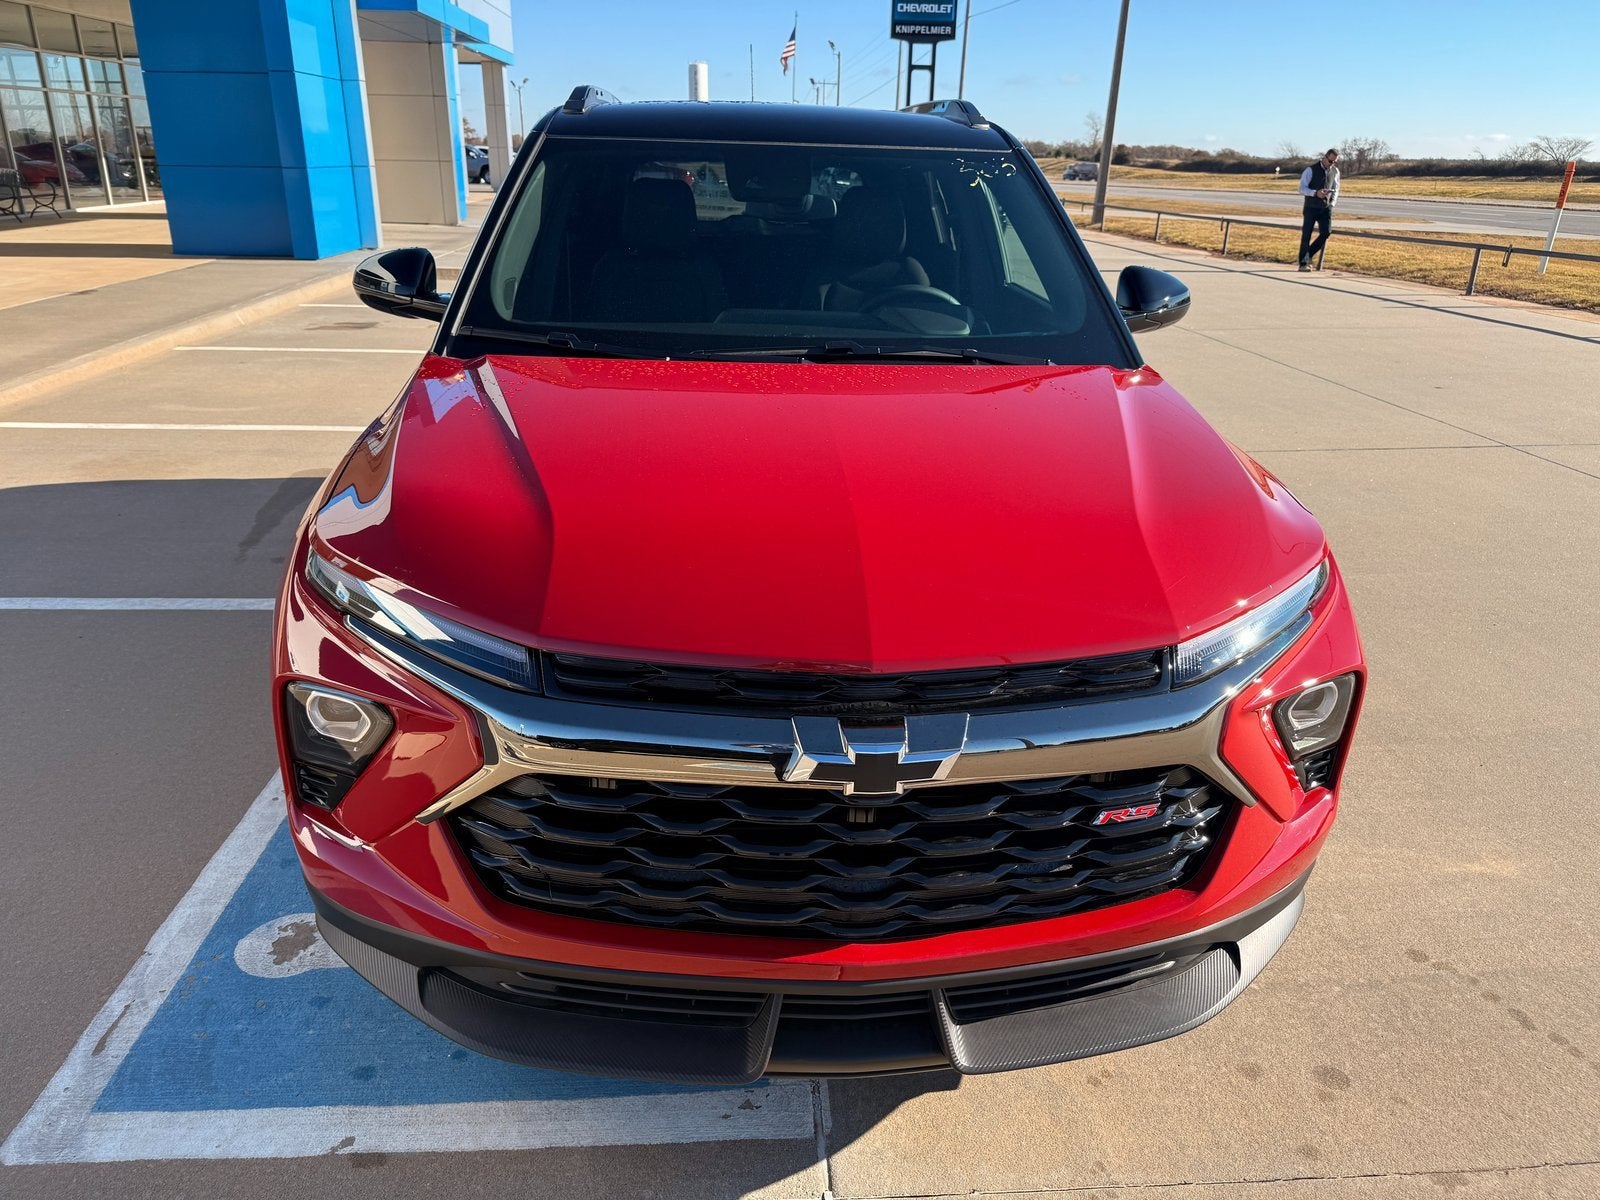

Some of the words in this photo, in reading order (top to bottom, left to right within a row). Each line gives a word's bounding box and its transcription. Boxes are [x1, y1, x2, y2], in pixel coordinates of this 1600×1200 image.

[897, 3, 952, 13] CHEVROLET
[895, 25, 951, 34] KNIPPELMIER
[1092, 803, 1160, 824] RS
